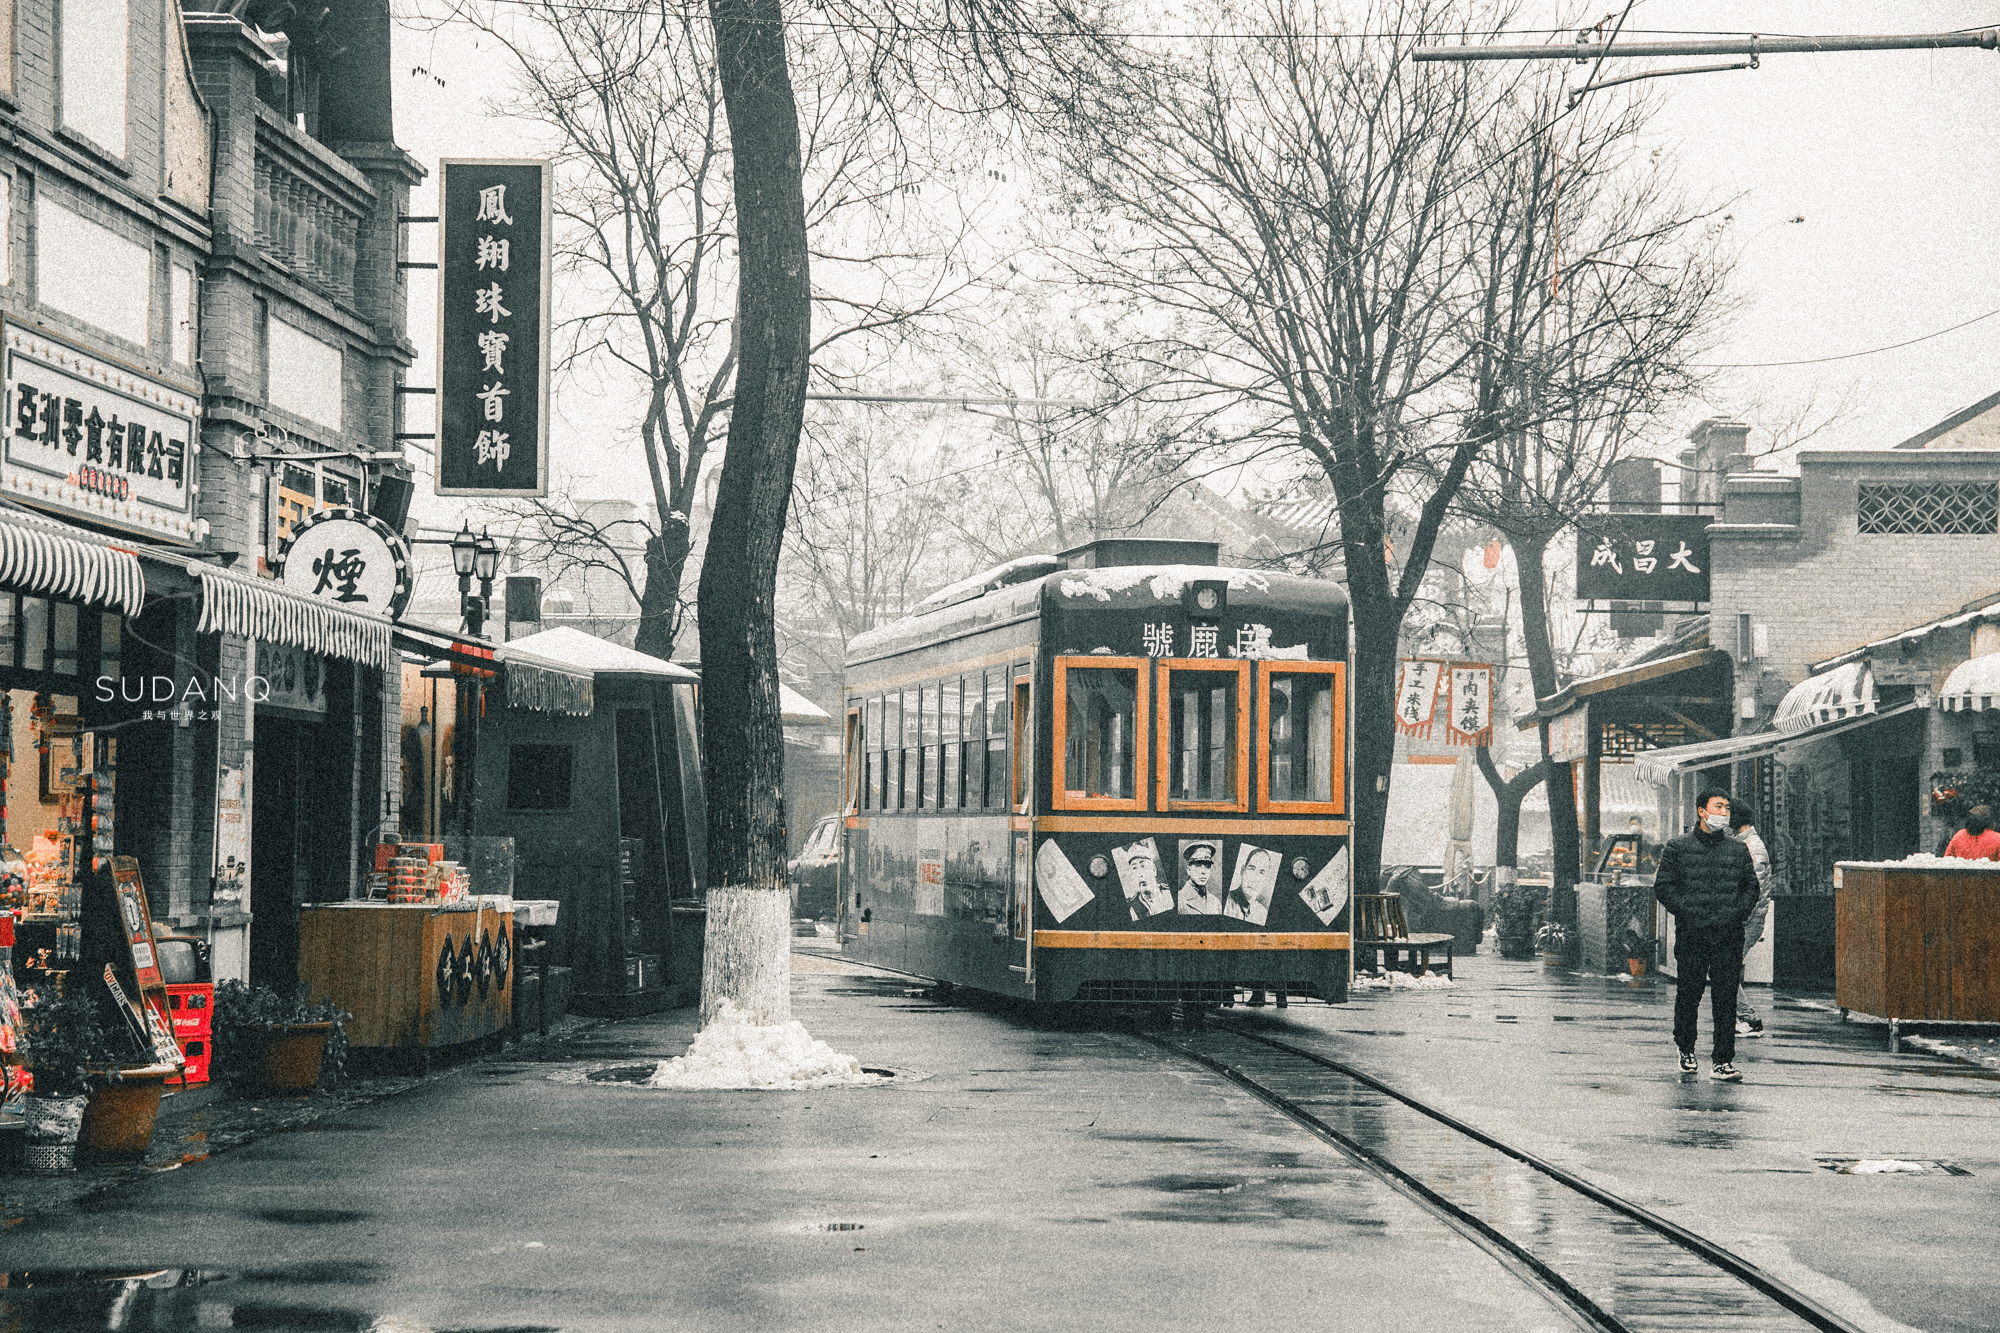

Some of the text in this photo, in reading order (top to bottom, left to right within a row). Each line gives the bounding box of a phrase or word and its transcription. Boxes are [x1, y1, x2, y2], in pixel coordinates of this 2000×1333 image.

[472, 184, 514, 472] 鳳翔珠寶首飾
[312, 548, 369, 603] 煙
[1403, 662, 1428, 722] 手工米线
[1460, 681, 1481, 732] 肉夹馍
